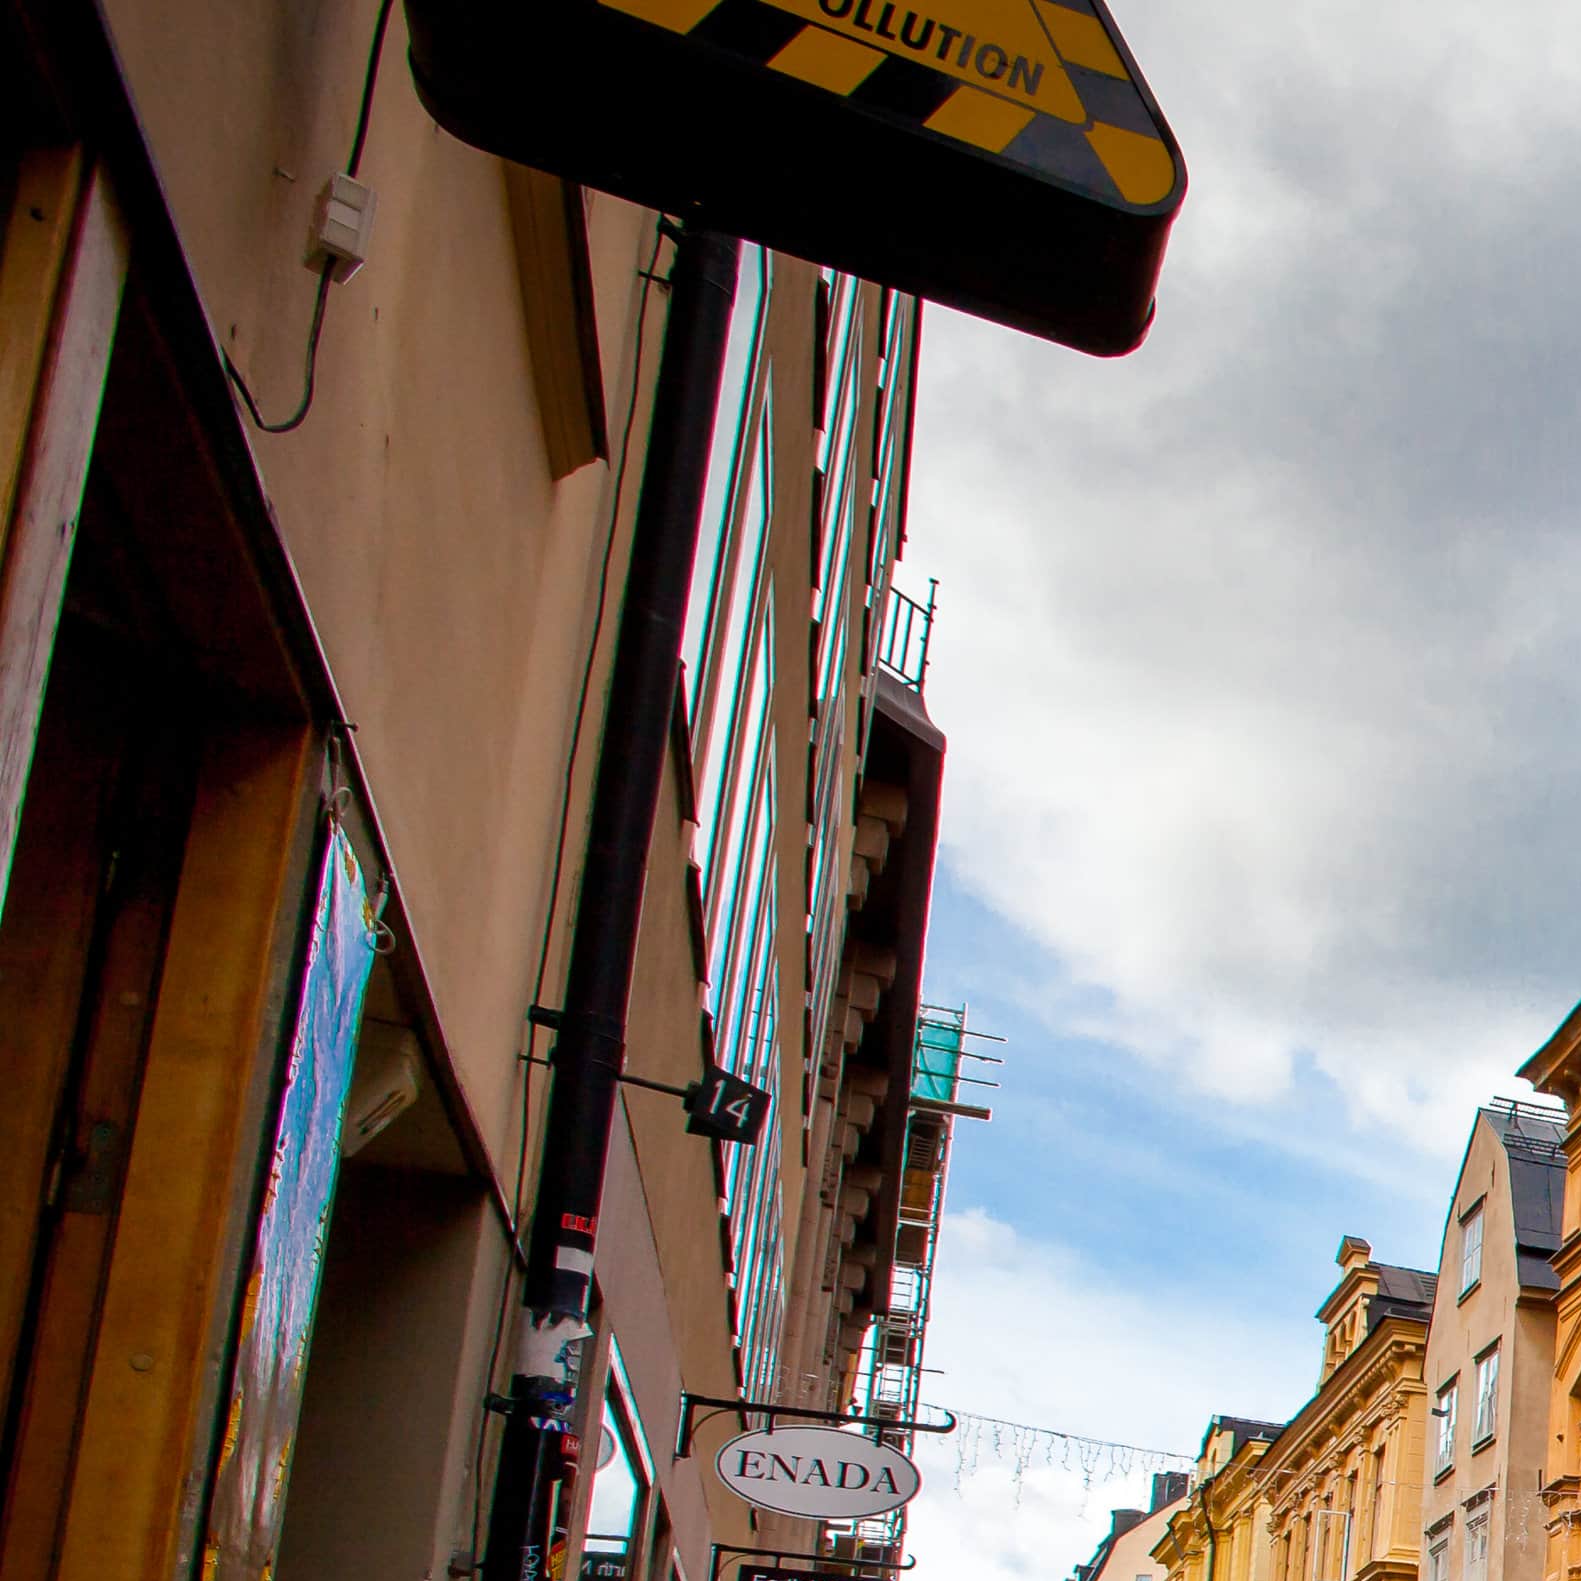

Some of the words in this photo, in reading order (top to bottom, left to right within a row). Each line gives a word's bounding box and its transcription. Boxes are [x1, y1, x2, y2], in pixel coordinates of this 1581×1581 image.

[819, 0, 1045, 96] OLLUTION
[707, 1079, 751, 1128] 14
[734, 1449, 901, 1495] ENADA
